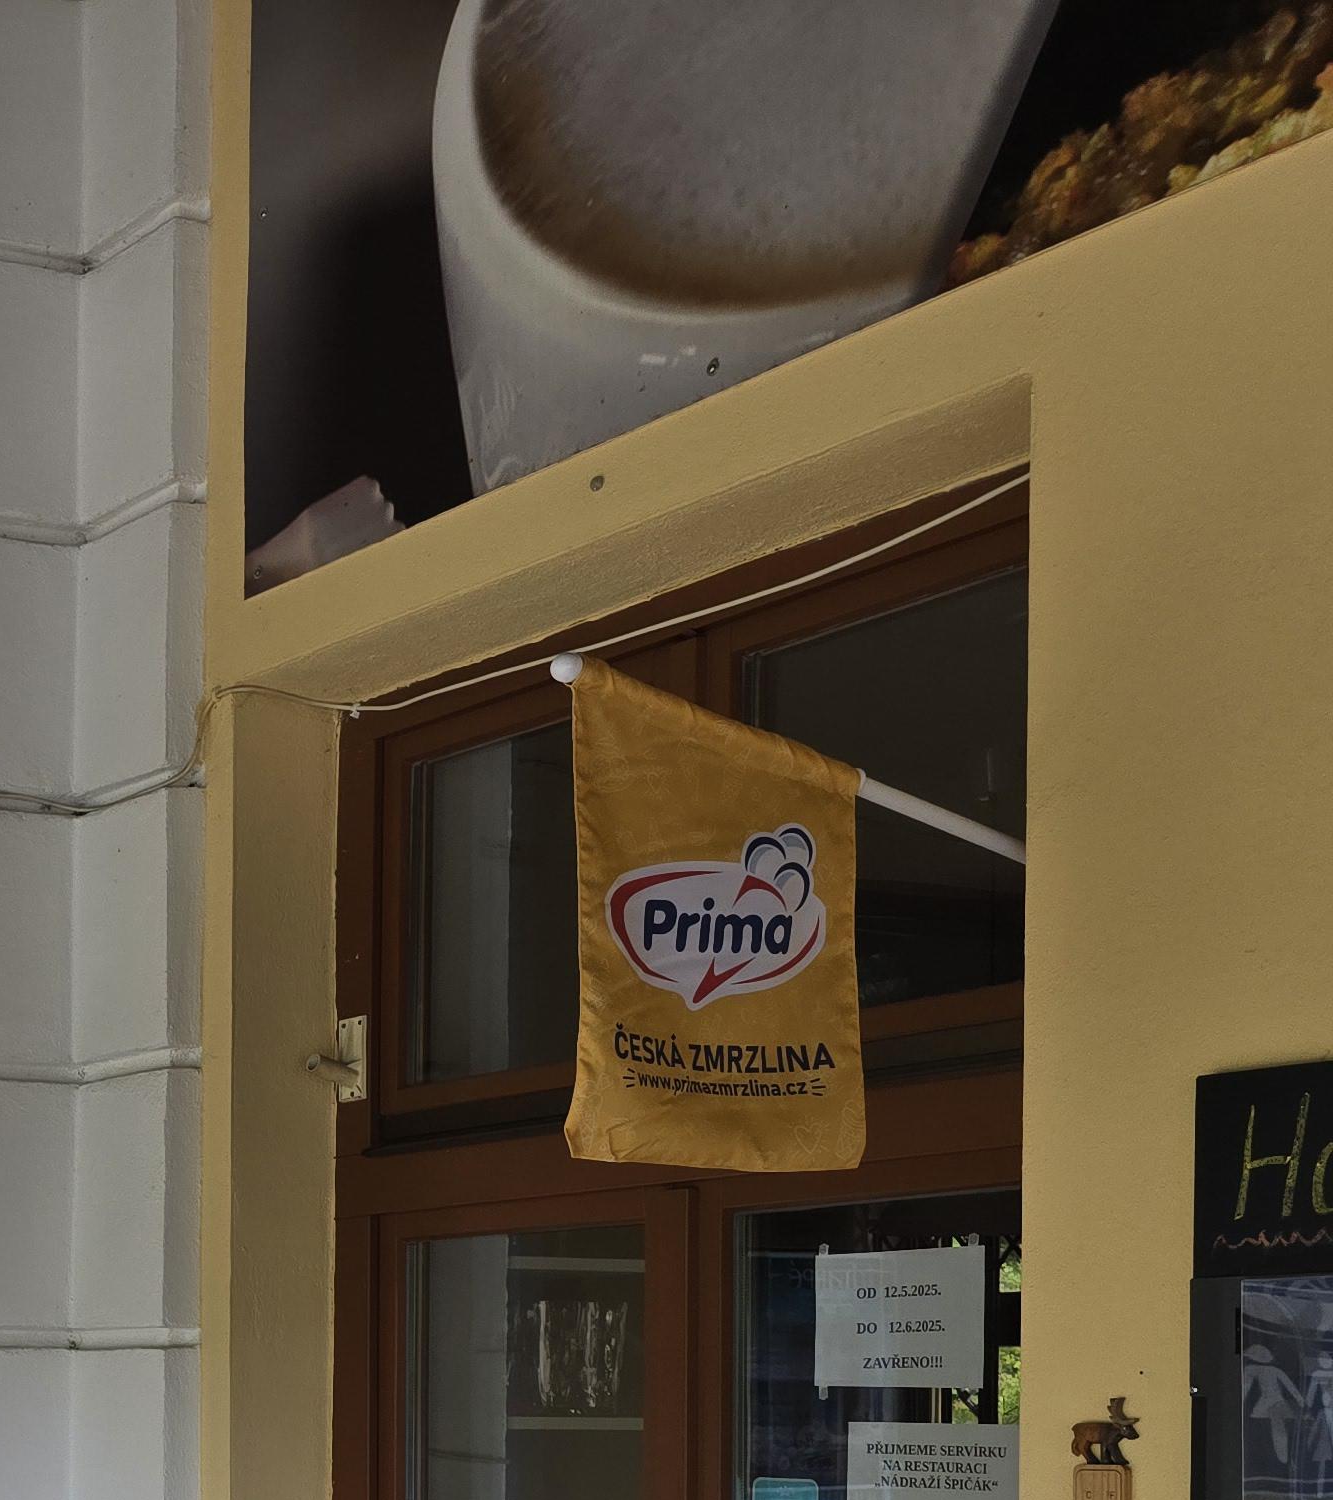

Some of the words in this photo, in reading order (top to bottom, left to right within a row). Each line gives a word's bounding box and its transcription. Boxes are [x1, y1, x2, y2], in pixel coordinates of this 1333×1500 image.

[643, 897, 793, 955] Prima
[614, 1022, 686, 1070] ČESKÁ
[688, 1042, 836, 1074] ZMRZLINA
[637, 1071, 808, 1097] www.primazmrzlina.cz
[856, 1287, 877, 1299] OD
[884, 1284, 941, 1298] 12.5.2025.
[856, 1322, 878, 1335] DO
[889, 1320, 945, 1334] 12.6.2025.
[862, 1353, 943, 1370] ZAVŘENO!!!
[866, 1441, 937, 1456] PŘIJMEME
[939, 1443, 1007, 1458] SERVÍRKU
[882, 1459, 902, 1472] NA
[904, 1460, 988, 1475] RESTAURACI
